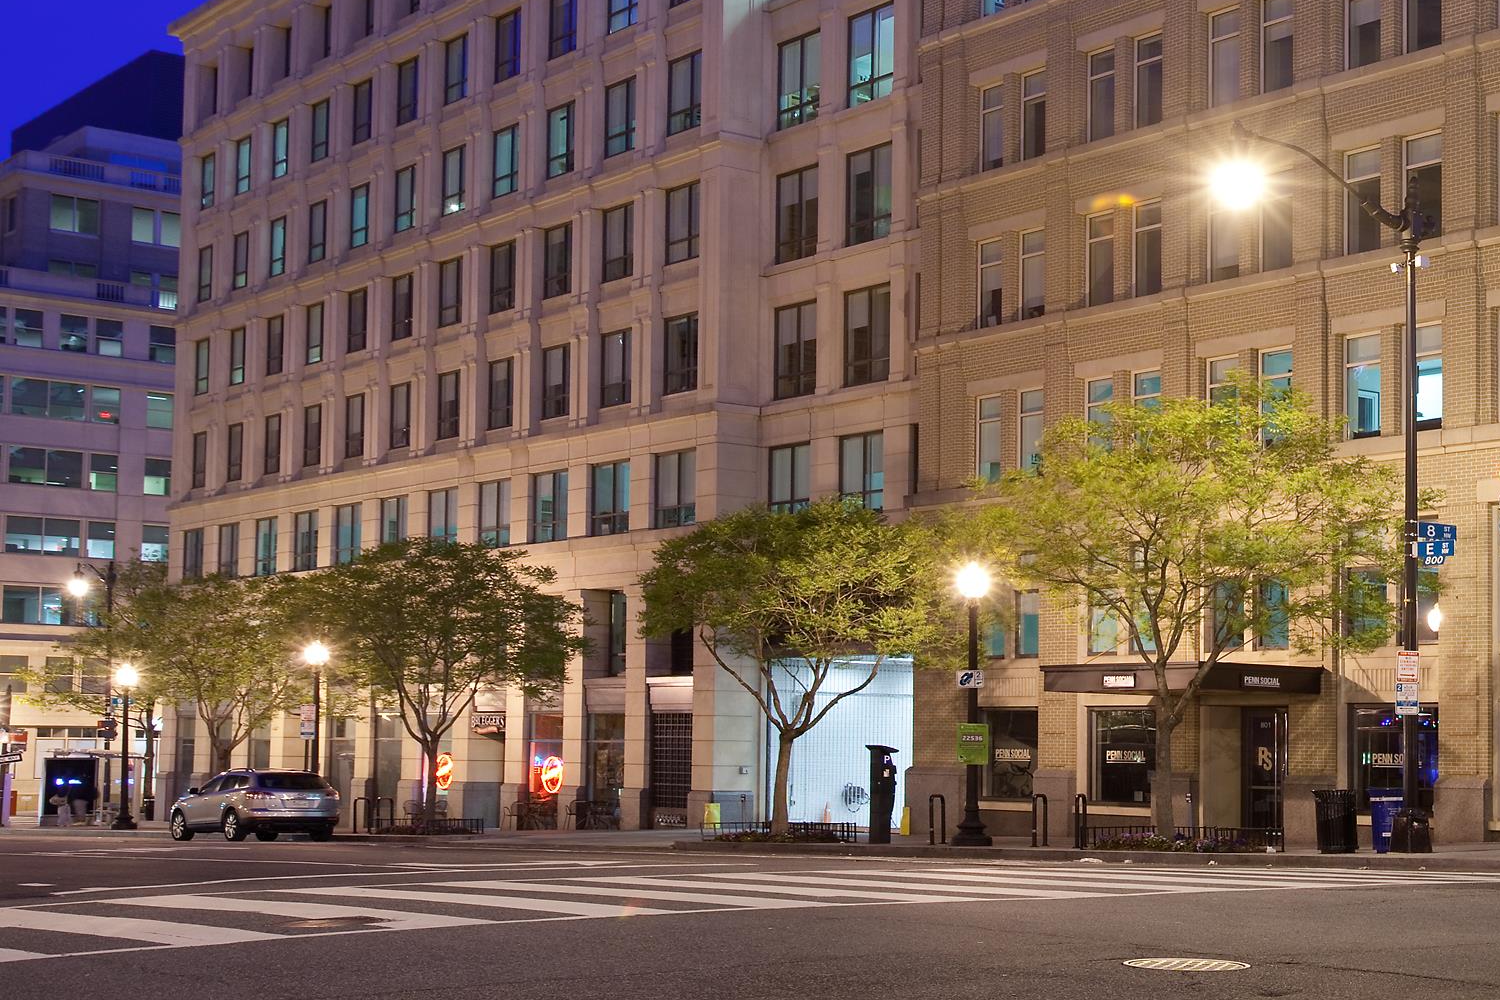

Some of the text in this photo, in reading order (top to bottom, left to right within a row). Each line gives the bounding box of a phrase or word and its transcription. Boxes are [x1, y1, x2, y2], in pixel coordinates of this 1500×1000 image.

[1427, 525, 1436, 537] 8
[1426, 543, 1434, 555] E
[1424, 556, 1444, 565] 800
[1244, 675, 1280, 686] PENN SOCIAL
[995, 748, 1010, 758] PENN
[1106, 750, 1146, 761] PENN SOCIAL
[1372, 753, 1392, 764] PENN
[884, 755, 890, 764] P
